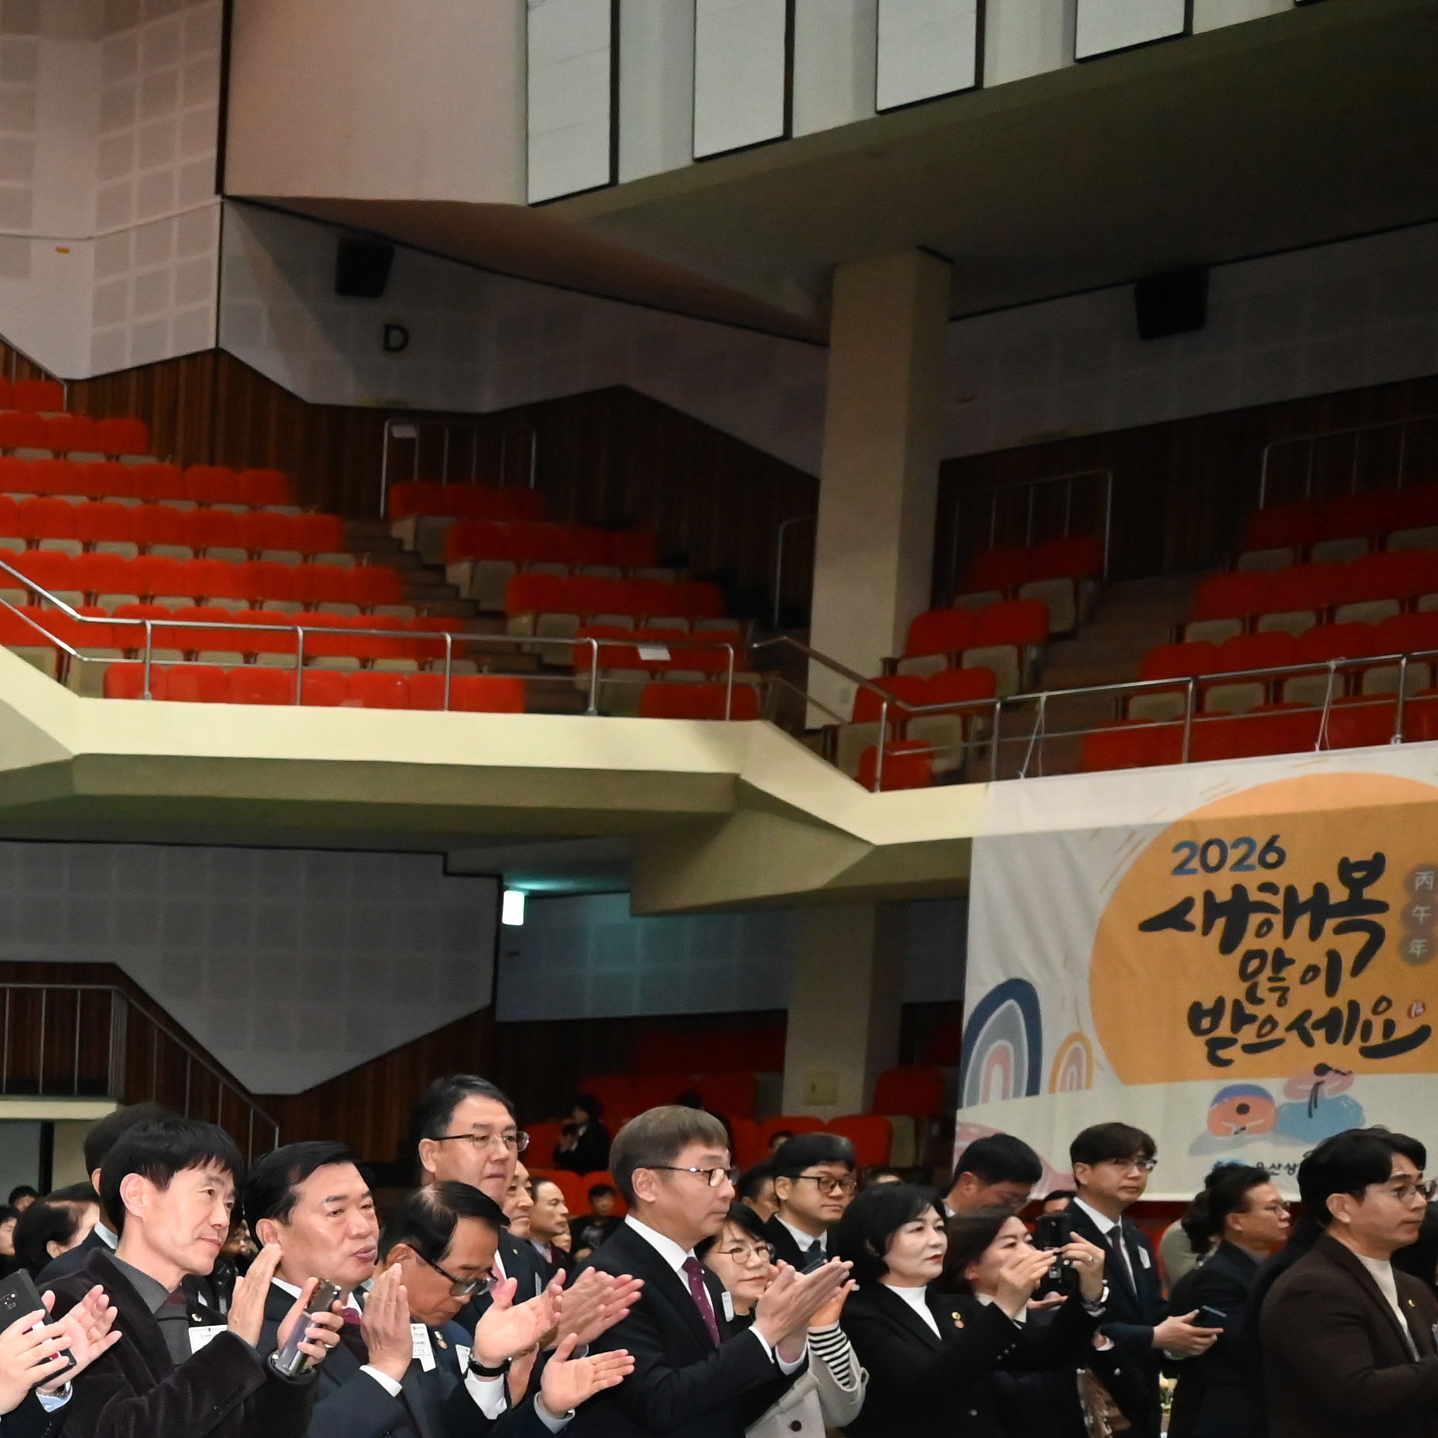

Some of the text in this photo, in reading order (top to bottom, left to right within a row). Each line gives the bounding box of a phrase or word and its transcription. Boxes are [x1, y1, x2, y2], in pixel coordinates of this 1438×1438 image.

[384, 324, 409, 352] D
[1170, 835, 1286, 876] 2026
[1187, 996, 1431, 1067] 받으세요
